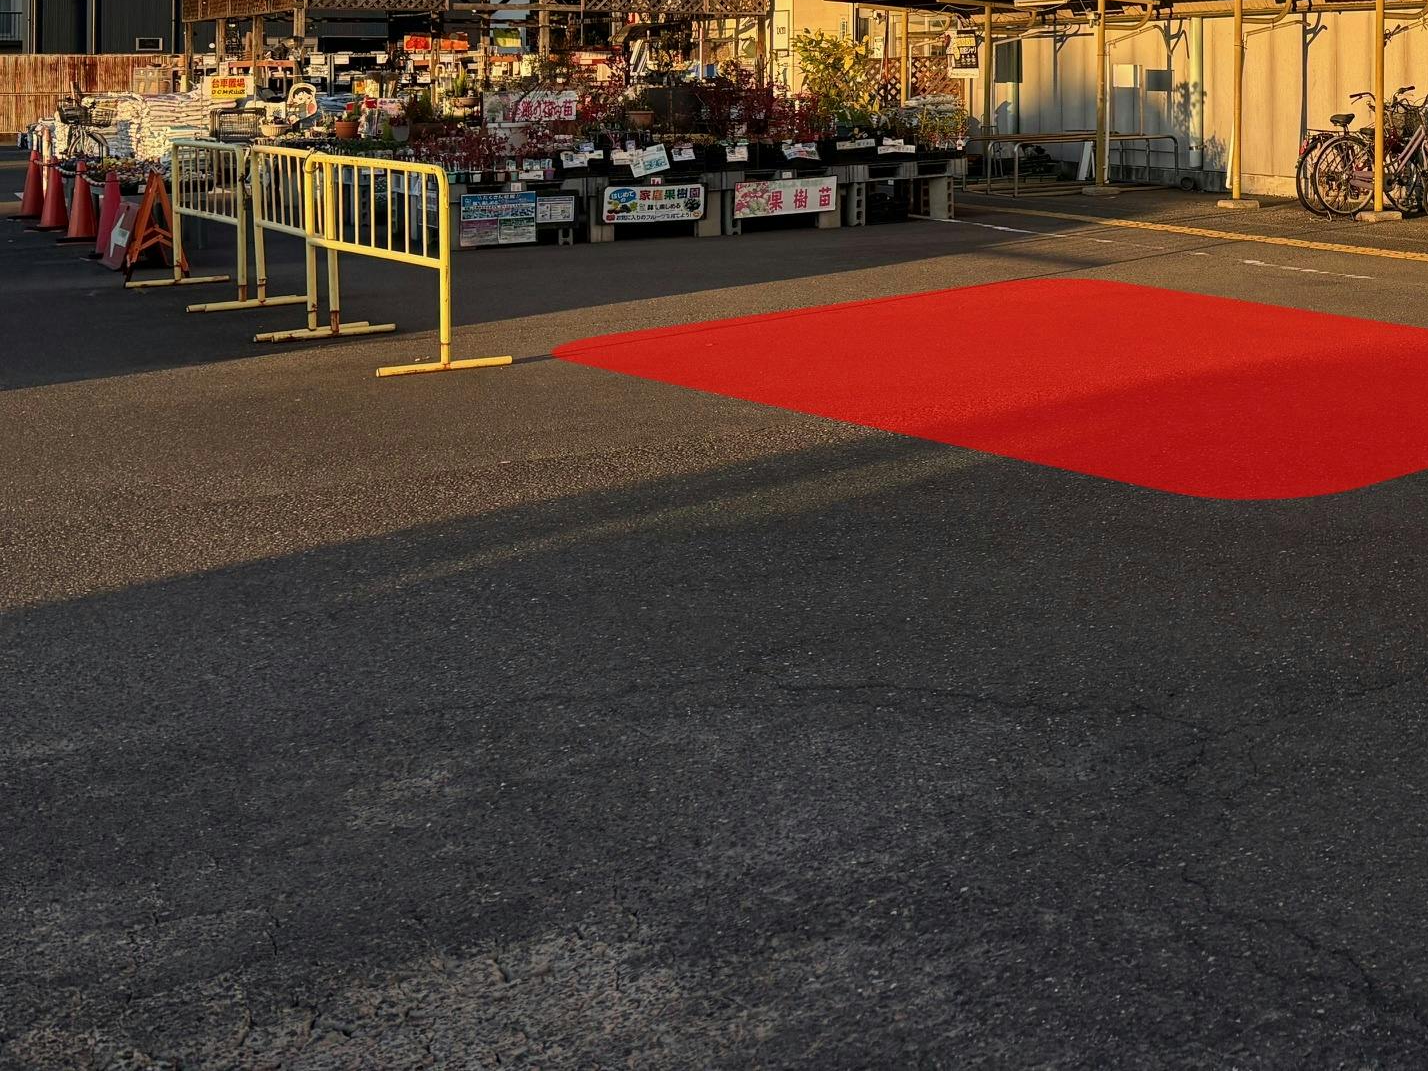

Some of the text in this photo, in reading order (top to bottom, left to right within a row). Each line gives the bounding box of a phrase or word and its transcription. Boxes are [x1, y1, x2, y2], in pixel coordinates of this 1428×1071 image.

[639, 187, 701, 201] 家庭果樹園
